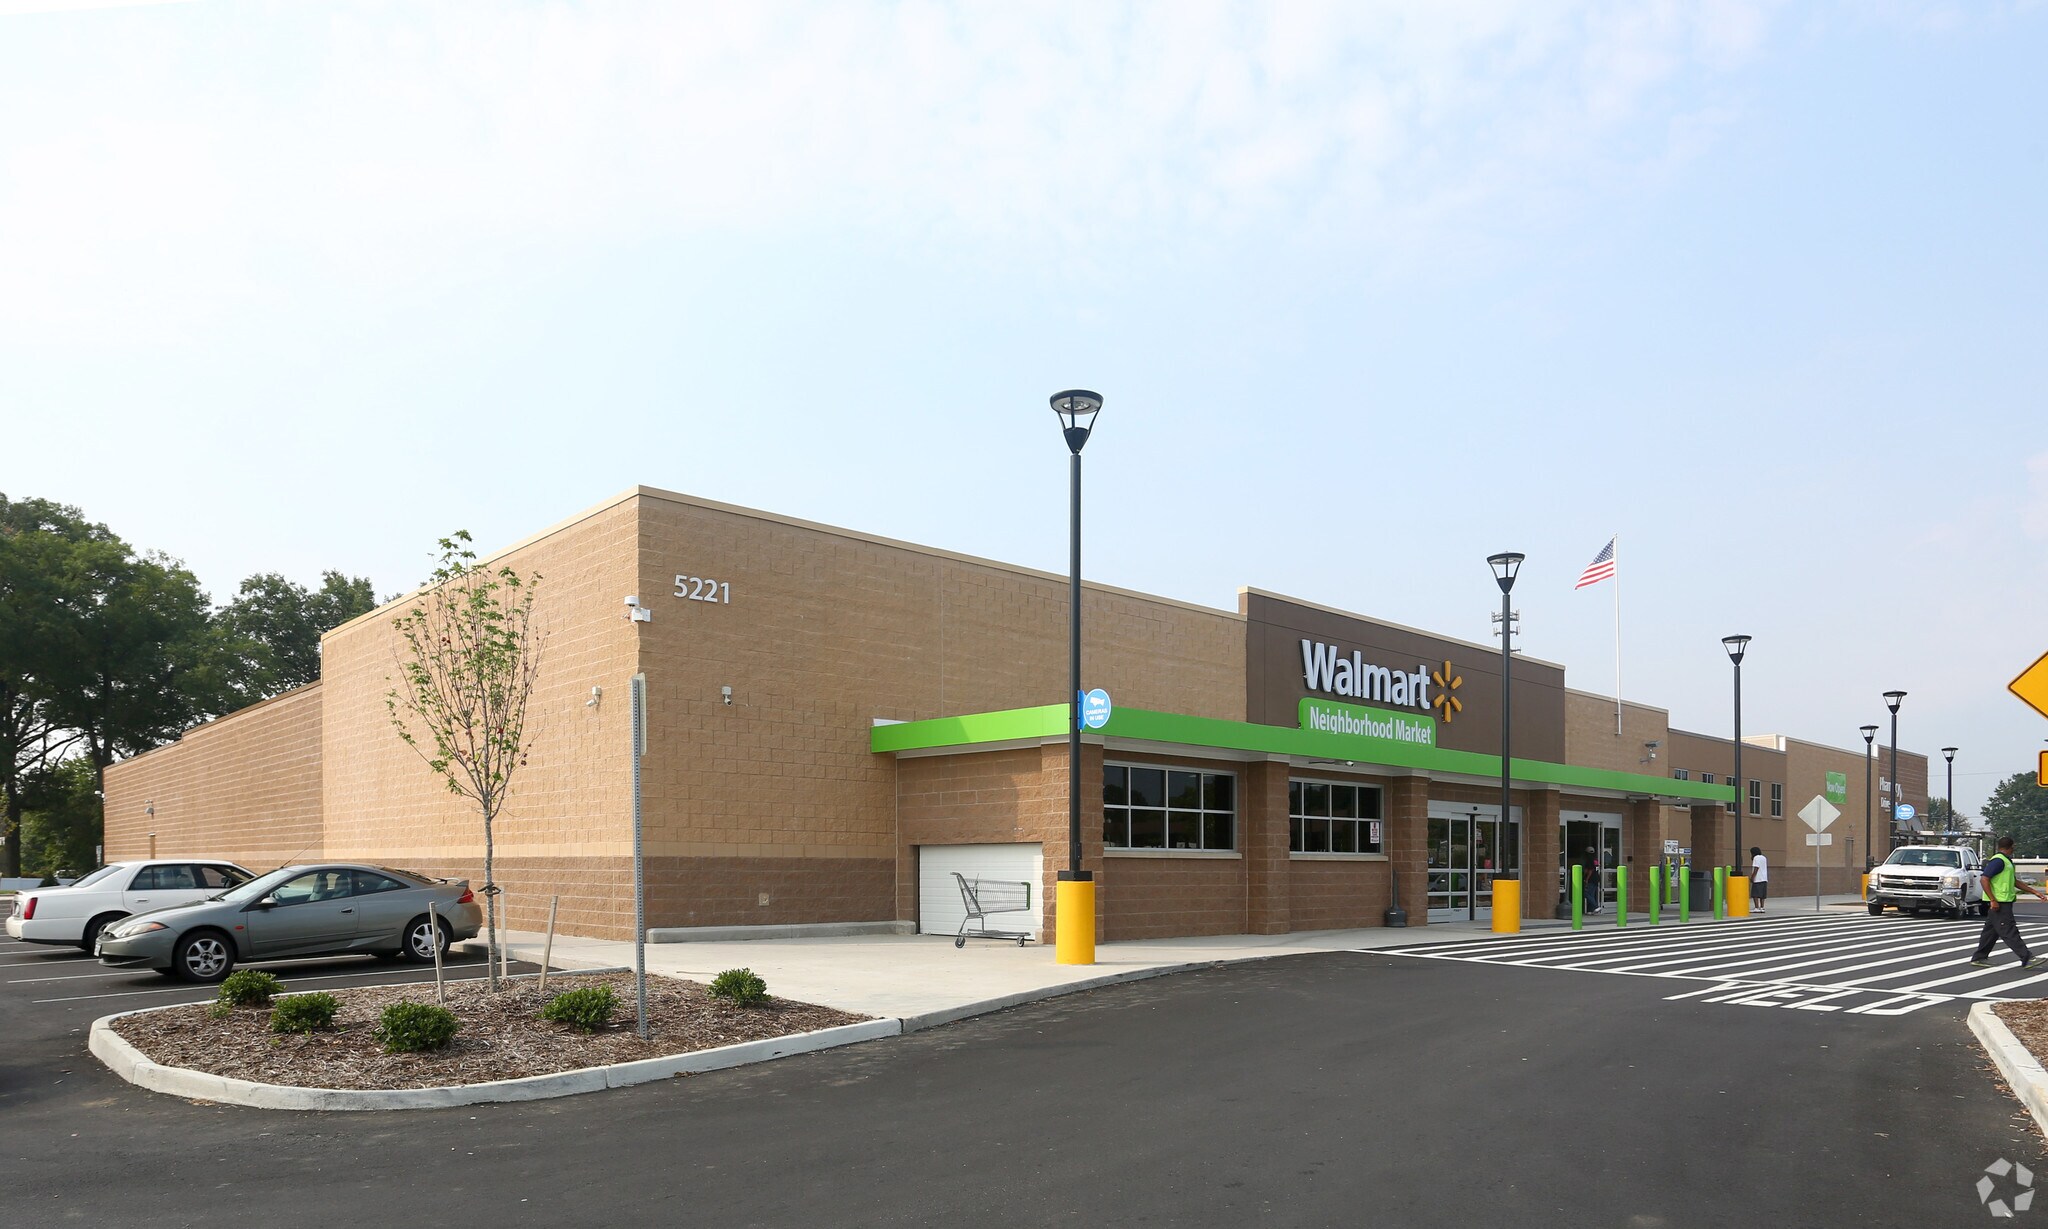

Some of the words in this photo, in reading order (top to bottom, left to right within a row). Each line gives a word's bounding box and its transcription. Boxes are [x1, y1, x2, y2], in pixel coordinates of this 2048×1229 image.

[673, 574, 730, 604] 5221
[1301, 639, 1431, 710] Walmart
[1310, 706, 1393, 735] Neighborhood
[1395, 719, 1432, 745] Market
[1662, 980, 1956, 1016] YIELD
